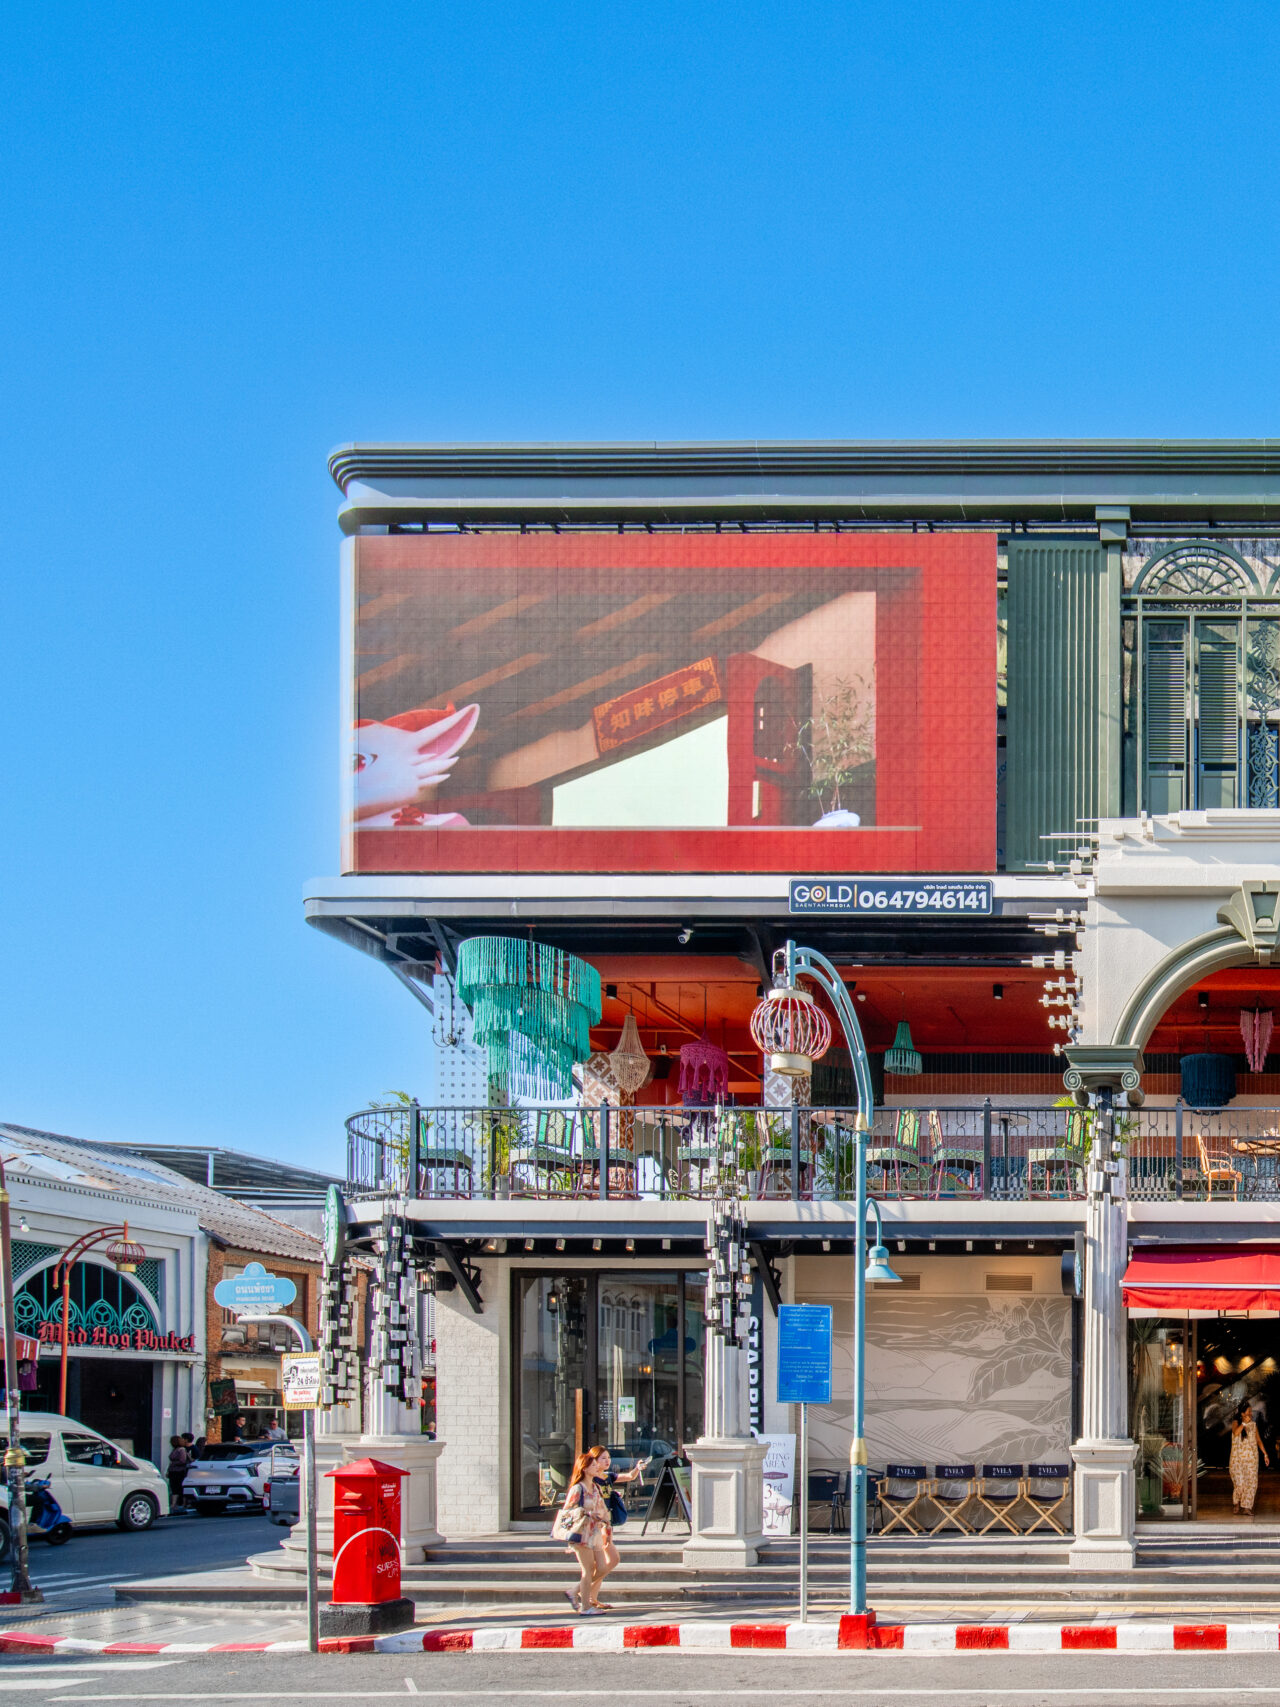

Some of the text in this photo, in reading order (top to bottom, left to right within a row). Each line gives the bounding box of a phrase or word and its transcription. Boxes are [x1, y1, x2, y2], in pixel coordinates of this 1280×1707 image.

[794, 885, 852, 903] GOLD
[859, 890, 987, 909] 0647946141
[37, 1321, 197, 1351] Mad Hog Phuket
[764, 1483, 783, 1499] 3rd
